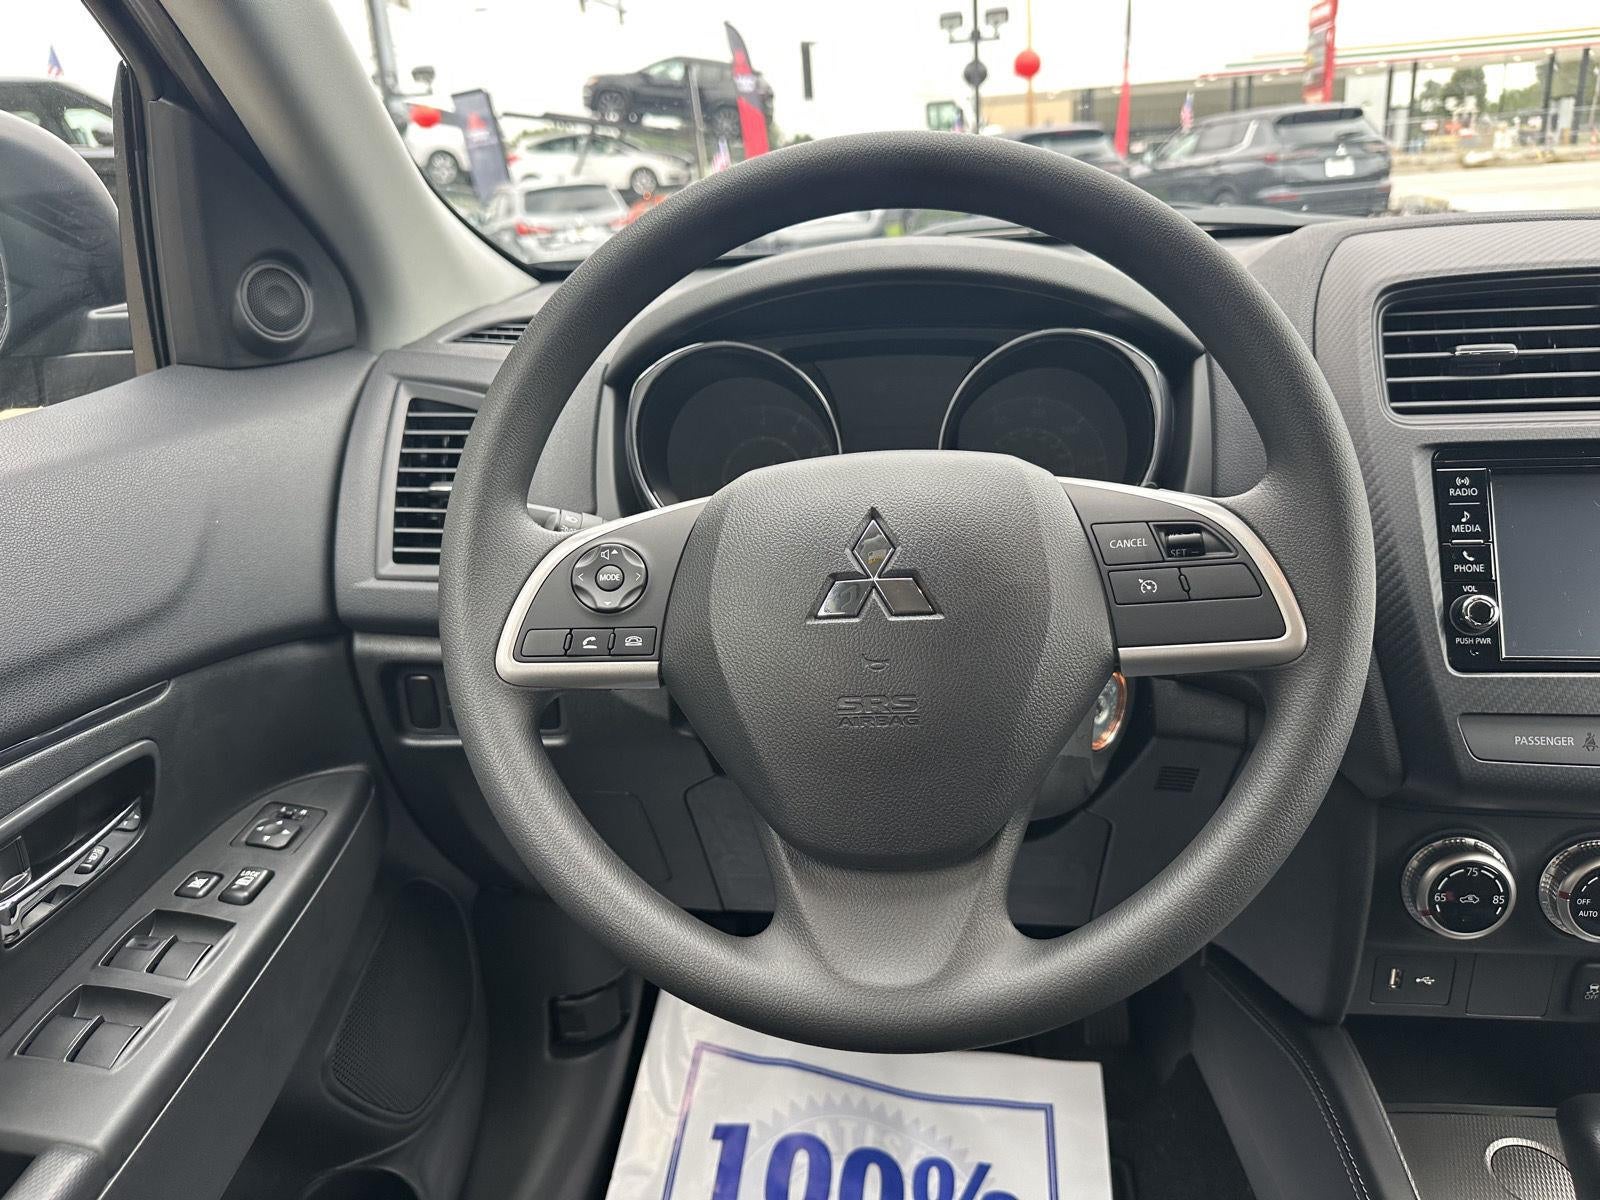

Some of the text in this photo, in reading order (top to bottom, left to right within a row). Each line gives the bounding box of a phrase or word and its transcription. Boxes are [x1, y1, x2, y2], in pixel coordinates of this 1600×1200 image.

[1449, 487, 1479, 496] RADIO
[1451, 524, 1482, 533] MEDIA
[1109, 538, 1148, 549] CANCEL
[1453, 564, 1485, 573] PHONE
[599, 573, 621, 581] MODE
[1455, 637, 1492, 645] PUSH PWR
[837, 695, 920, 714] SRS
[838, 716, 920, 728] AIRBAG
[1514, 735, 1575, 746] PASSENGER
[1467, 867, 1479, 876] 75
[1434, 893, 1447, 902] 65
[1492, 895, 1505, 904] 85
[1578, 910, 1598, 918] AUTO
